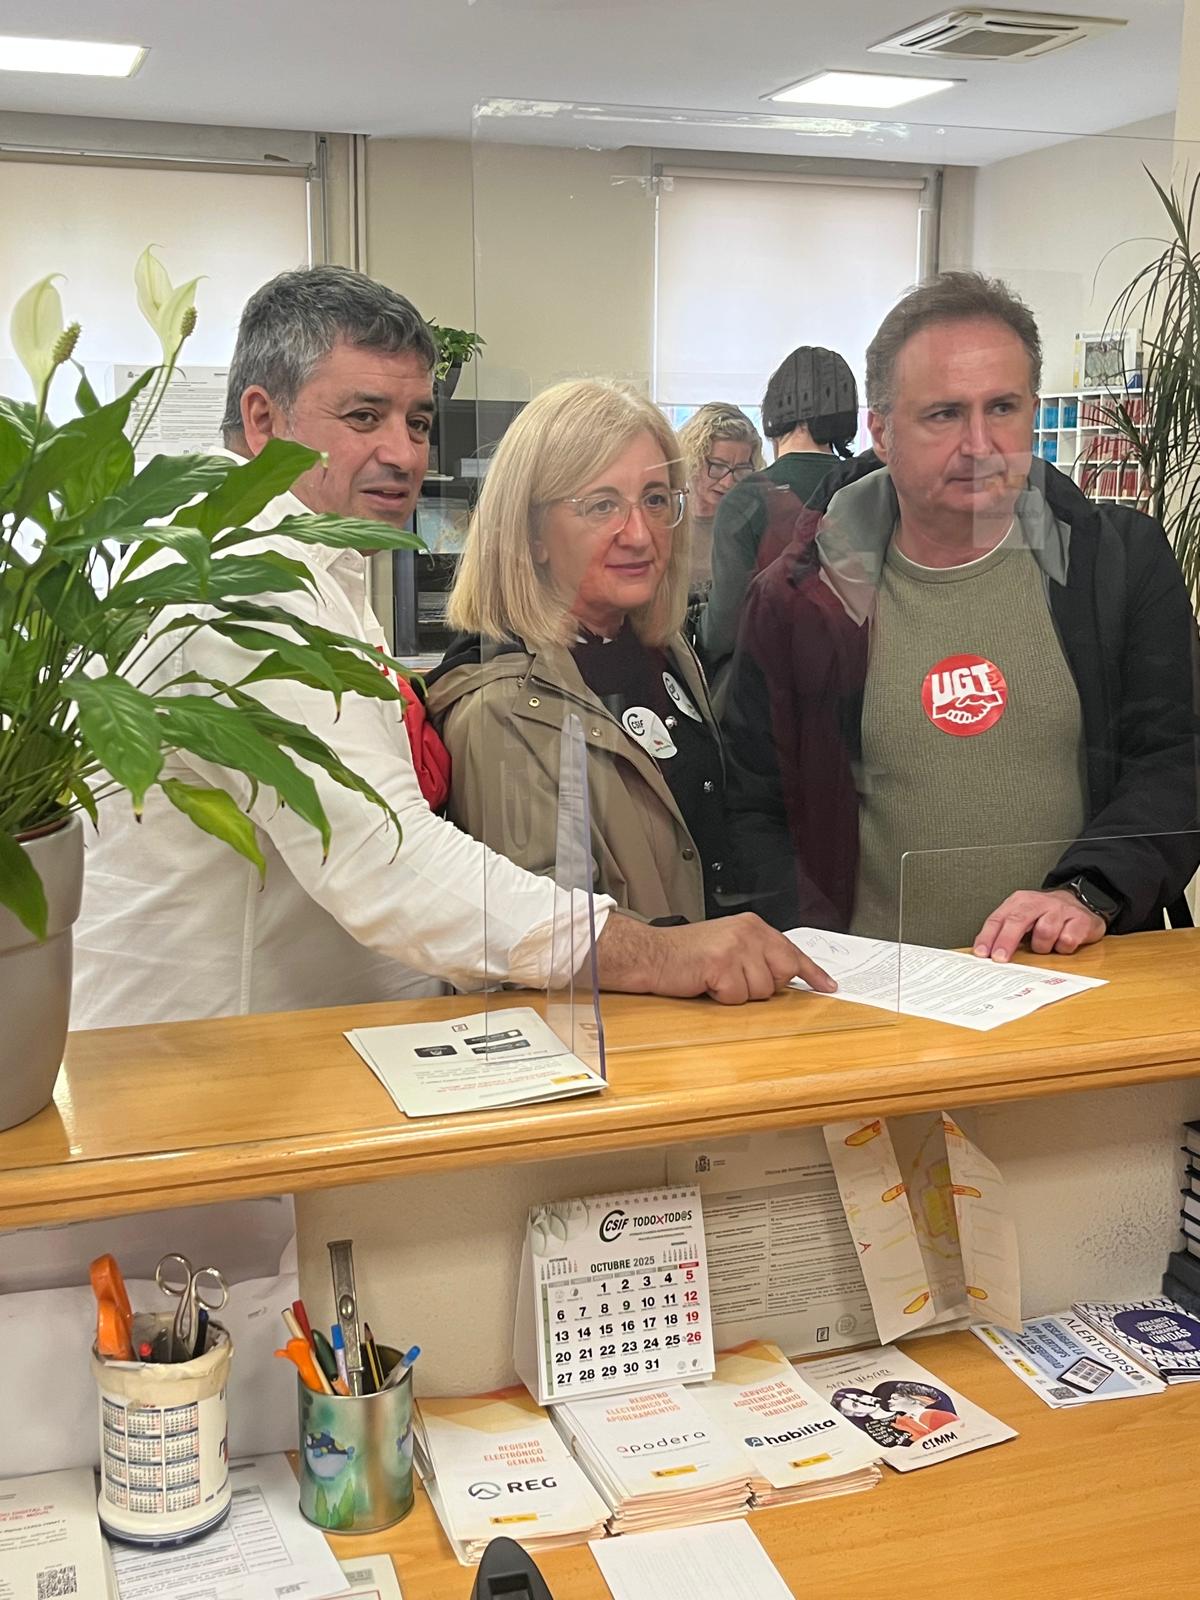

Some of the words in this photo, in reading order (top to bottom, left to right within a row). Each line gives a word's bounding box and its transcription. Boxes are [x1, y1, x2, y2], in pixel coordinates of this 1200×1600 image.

[931, 663, 991, 704] UGT
[591, 1258, 631, 1273] OCTUBRE
[633, 1256, 655, 1267] 2025
[601, 1283, 606, 1293] 1
[621, 1279, 629, 1290] 2
[643, 1276, 650, 1286] 3
[665, 1273, 672, 1283] 4
[686, 1270, 693, 1280] 5
[557, 1310, 565, 1320] 6
[579, 1307, 586, 1317] 7
[601, 1304, 608, 1313] 8
[623, 1301, 630, 1310] 9
[641, 1297, 654, 1307] 10
[664, 1294, 676, 1304] 11
[684, 1291, 698, 1301] 12
[555, 1331, 569, 1341] 13
[577, 1327, 591, 1338] 14
[600, 1324, 613, 1335] 15
[621, 1321, 635, 1331] 16
[643, 1318, 656, 1328] 17
[664, 1314, 677, 1324] 18
[686, 1311, 699, 1321] 19
[1148, 1328, 1192, 1344] UNIDAS
[556, 1352, 571, 1363] 20
[579, 1348, 593, 1359] 21
[600, 1345, 615, 1356] 22
[622, 1342, 637, 1352] 23
[644, 1338, 658, 1349] 24
[665, 1335, 680, 1345] 25
[687, 1332, 701, 1342] 26
[1060, 1317, 1134, 1374] ALERTCOPS
[557, 1373, 572, 1384] 27
[579, 1370, 595, 1380] 28
[602, 1366, 617, 1377] 29
[623, 1363, 639, 1373] 30
[645, 1359, 659, 1369] 31
[629, 1391, 669, 1404] REGISTRO
[740, 1384, 775, 1398] SERVICIO
[774, 1381, 786, 1389] DE
[777, 1387, 794, 1397] POR
[663, 1398, 673, 1406] DE
[748, 1394, 801, 1413] FUNCIONARIO
[762, 1400, 808, 1417] HABILITADO
[606, 1405, 681, 1422] APODERAMIENTOS
[764, 1419, 837, 1445] habilita
[922, 1431, 958, 1450] CIMM
[498, 1440, 540, 1452] REGISTRO
[617, 1431, 706, 1454] apodera
[506, 1456, 547, 1467] GENERAL
[507, 1477, 558, 1493] REG
